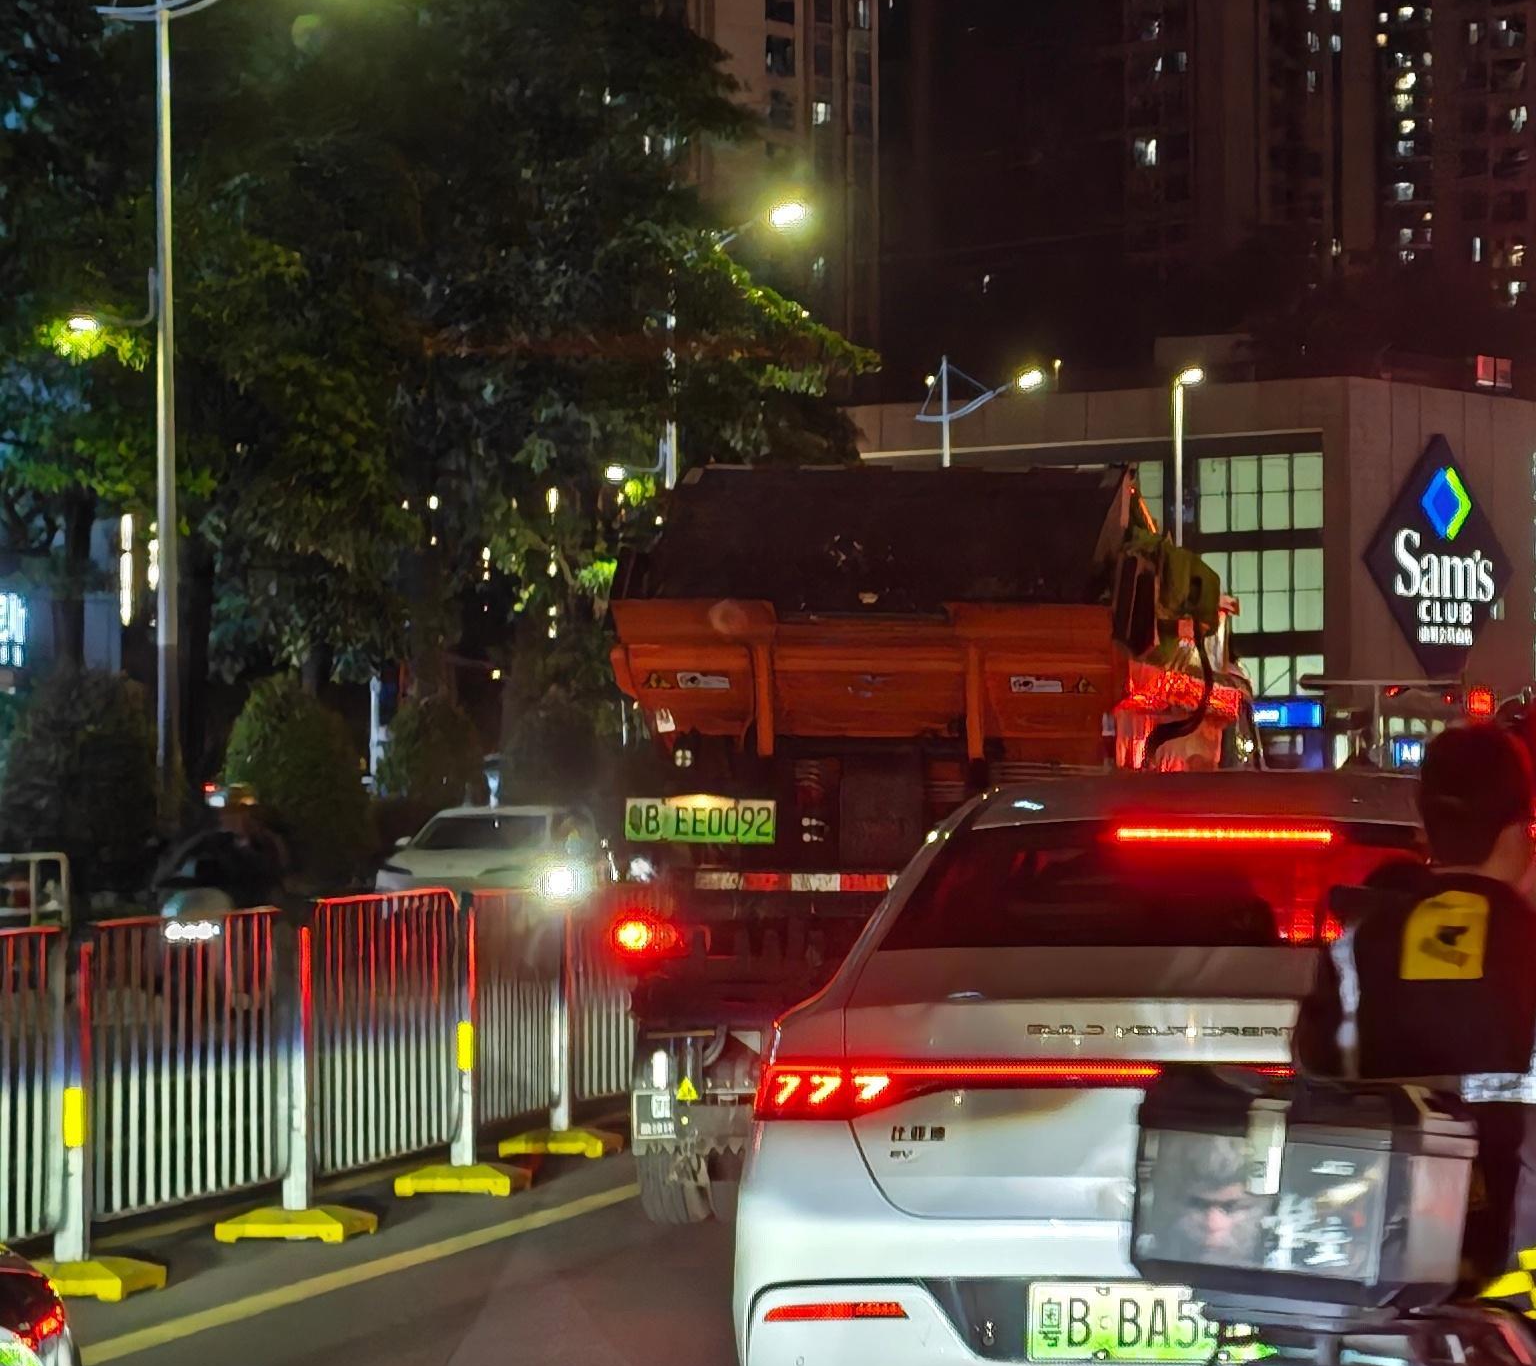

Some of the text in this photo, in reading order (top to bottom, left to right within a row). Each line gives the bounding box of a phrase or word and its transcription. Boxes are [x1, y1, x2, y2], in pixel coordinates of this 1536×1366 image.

[1394, 528, 1495, 601] Sam's
[1417, 600, 1473, 625] CLUB
[675, 806, 772, 837] EE0092
